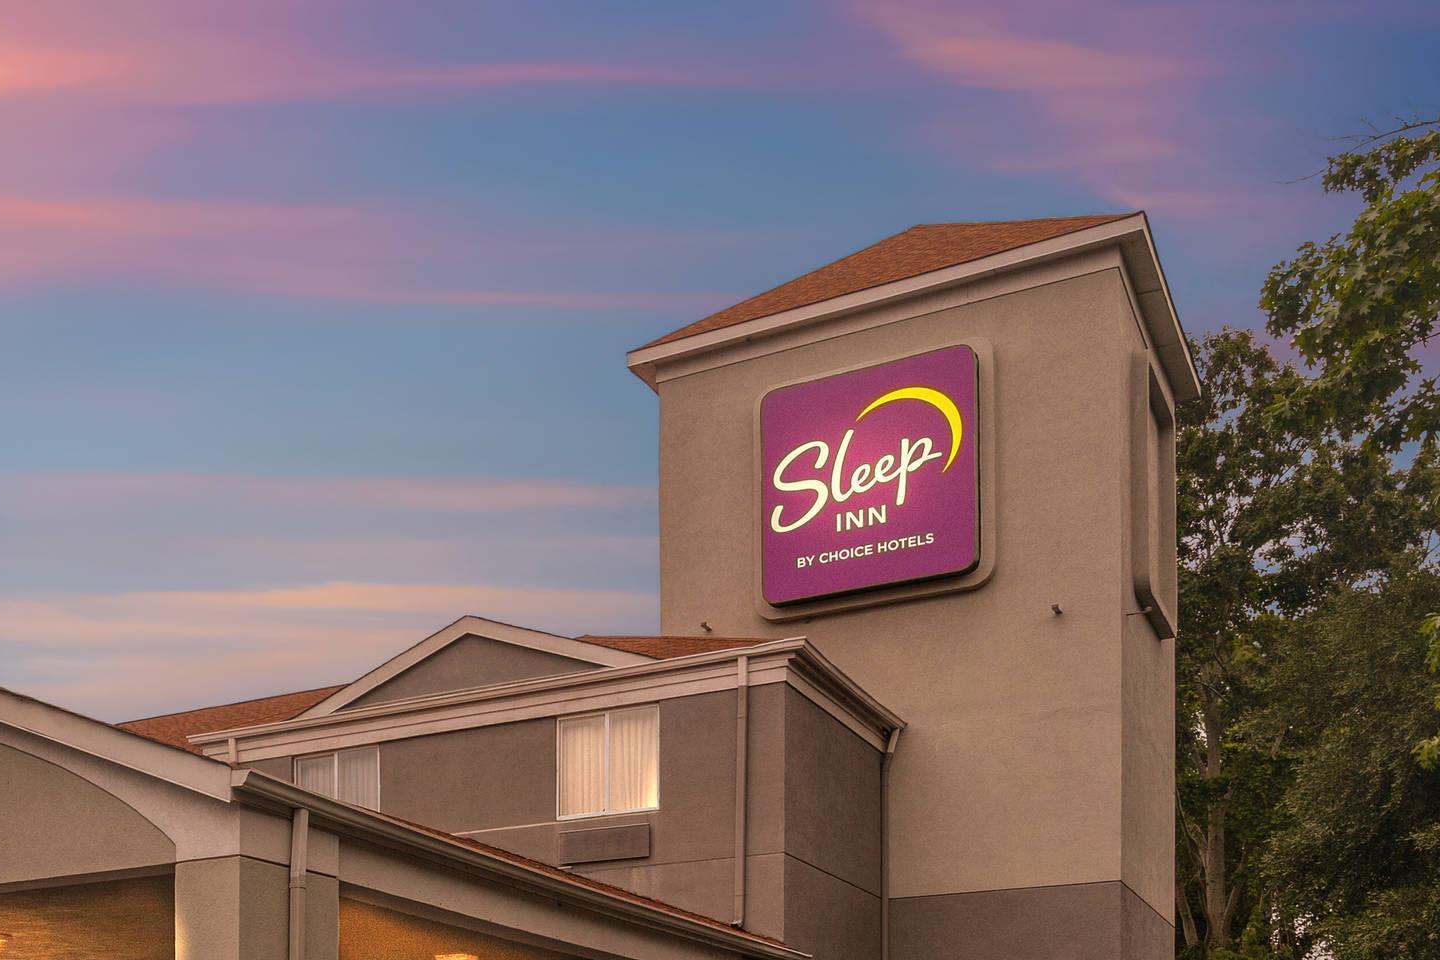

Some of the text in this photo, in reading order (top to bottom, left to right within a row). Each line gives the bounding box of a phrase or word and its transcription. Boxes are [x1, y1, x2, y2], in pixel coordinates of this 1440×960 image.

[771, 429, 942, 533] Sleep
[836, 504, 887, 532] INN
[796, 532, 935, 568] BY CHOICE HOTELS
